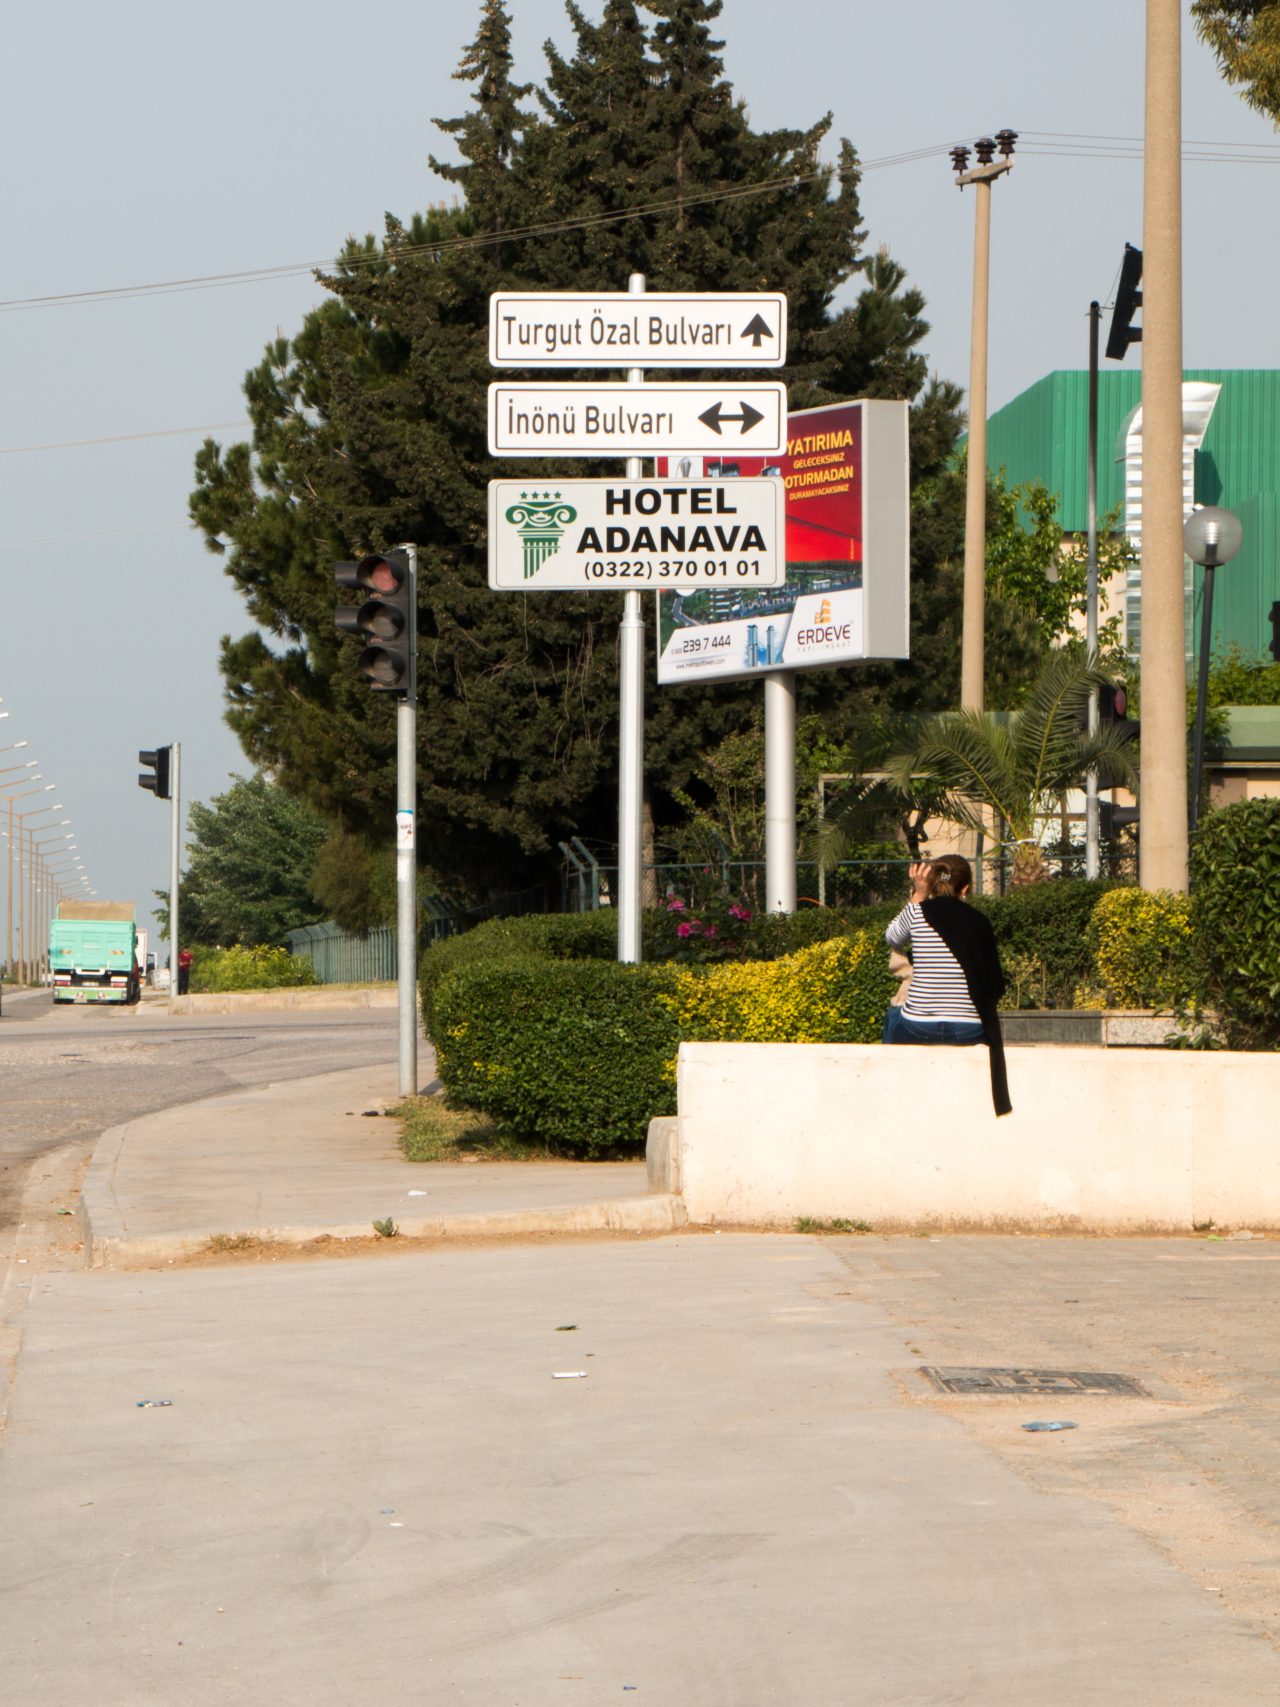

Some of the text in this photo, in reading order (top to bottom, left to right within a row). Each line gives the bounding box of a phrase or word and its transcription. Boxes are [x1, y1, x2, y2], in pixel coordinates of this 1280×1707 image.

[503, 309, 731, 352] Turgut Özal Bulvarı
[508, 399, 673, 435] İnönü Bulvarı
[787, 429, 853, 456] YATIRIMA
[785, 465, 854, 488] OTURMADAN
[605, 488, 737, 516] HOTEL
[576, 526, 767, 553] ADANAVA
[584, 560, 760, 580] (0322) 370 01 01
[683, 639, 701, 653] 239
[704, 637, 709, 651] 7
[711, 635, 731, 648] 444
[797, 623, 851, 645] ERDEVE
